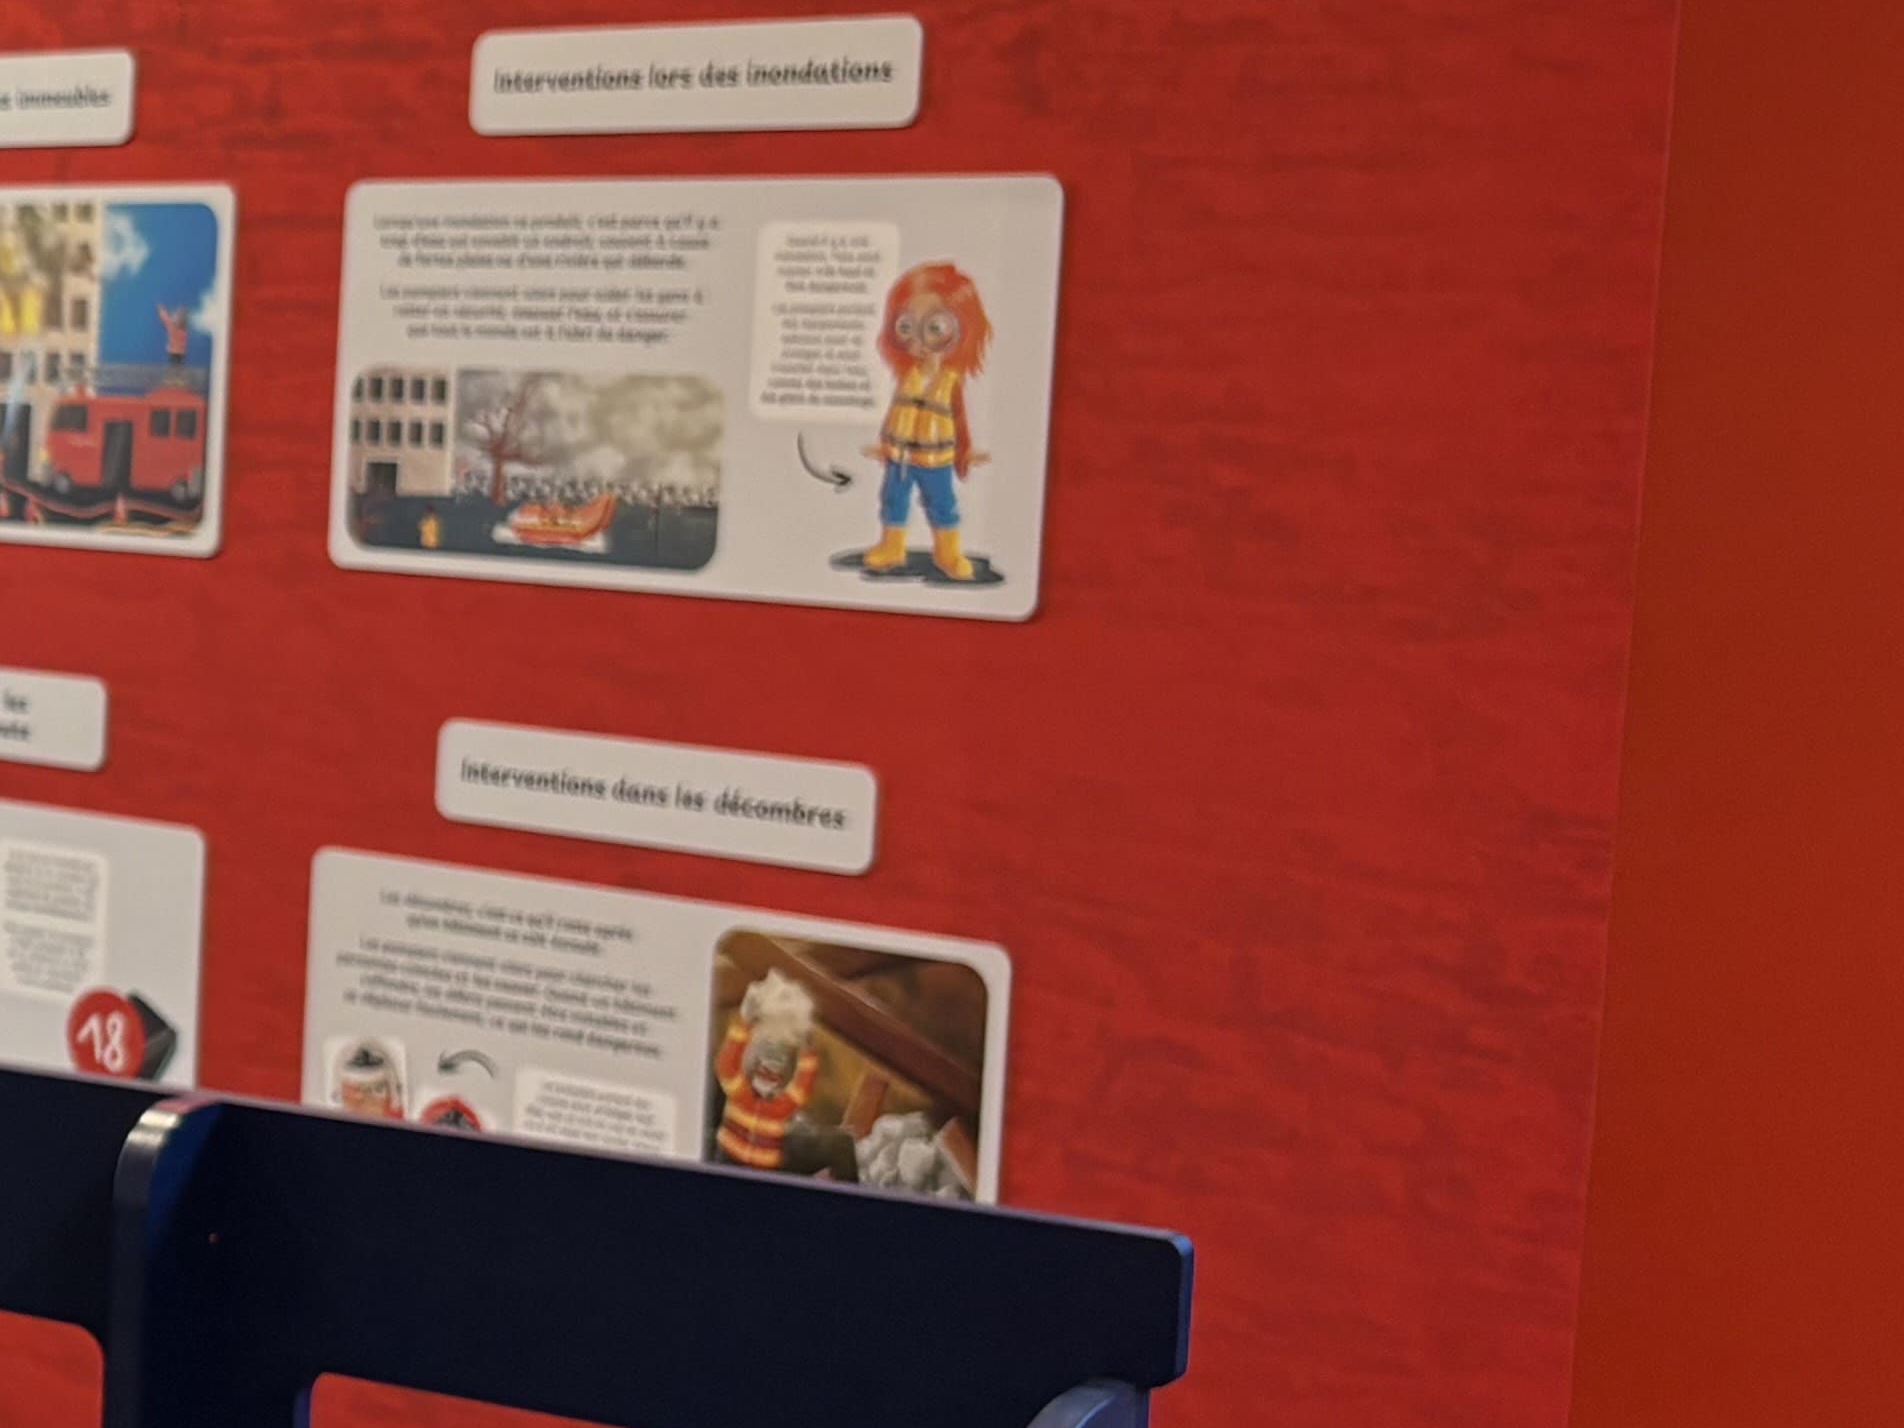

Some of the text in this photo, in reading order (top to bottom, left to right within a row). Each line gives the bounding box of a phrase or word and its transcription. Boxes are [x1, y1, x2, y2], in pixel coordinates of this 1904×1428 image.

[17, 83, 112, 110] immeubles
[493, 54, 894, 95] Interventions lors des inondations
[459, 756, 847, 832] Interventions dans les décombres
[76, 1009, 125, 1073] 18
